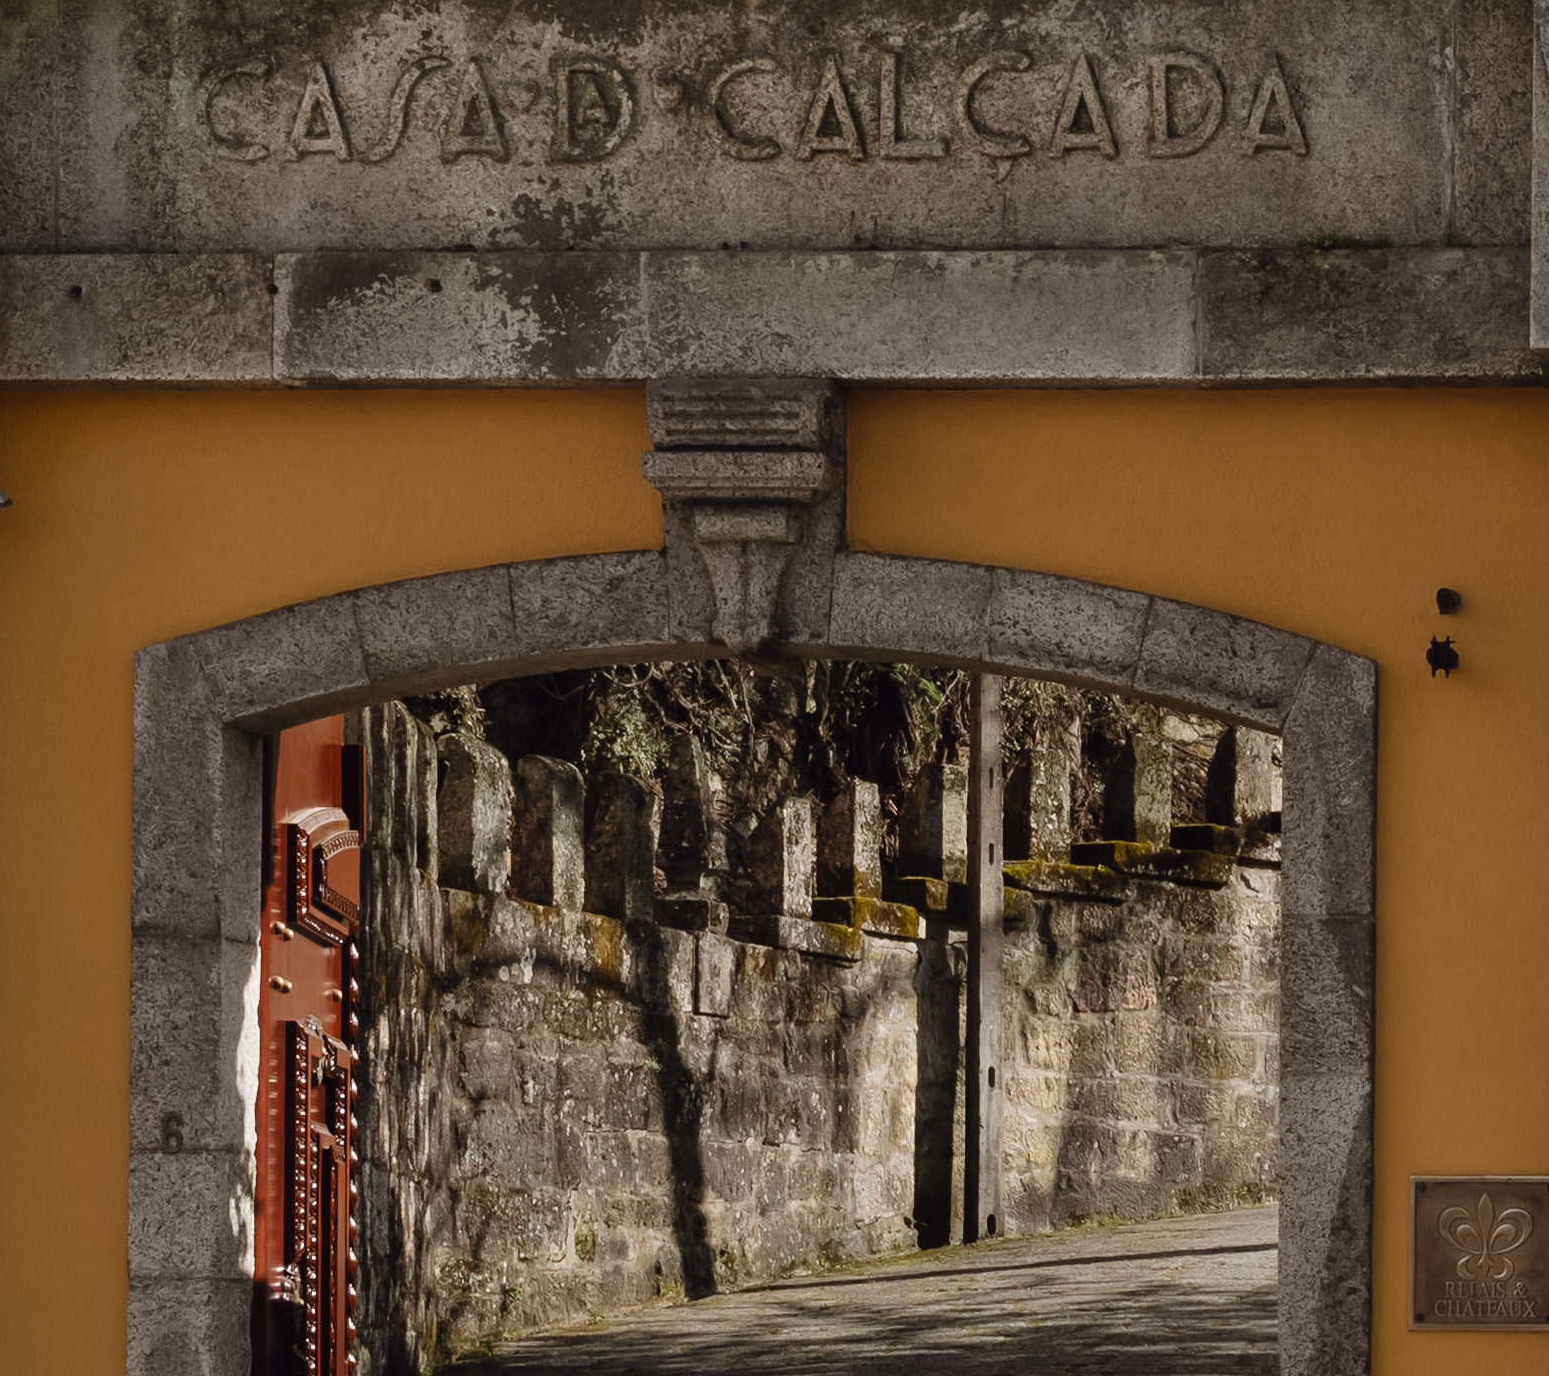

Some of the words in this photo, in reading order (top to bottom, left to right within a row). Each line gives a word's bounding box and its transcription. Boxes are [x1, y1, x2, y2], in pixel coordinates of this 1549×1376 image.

[203, 56, 510, 164] CASA
[708, 50, 1311, 185] CALÇADA
[161, 1111, 184, 1155] 6
[1445, 1281, 1506, 1299] RELAIS
[1513, 1281, 1528, 1299] &
[1433, 1299, 1537, 1318] CHATEAUX
